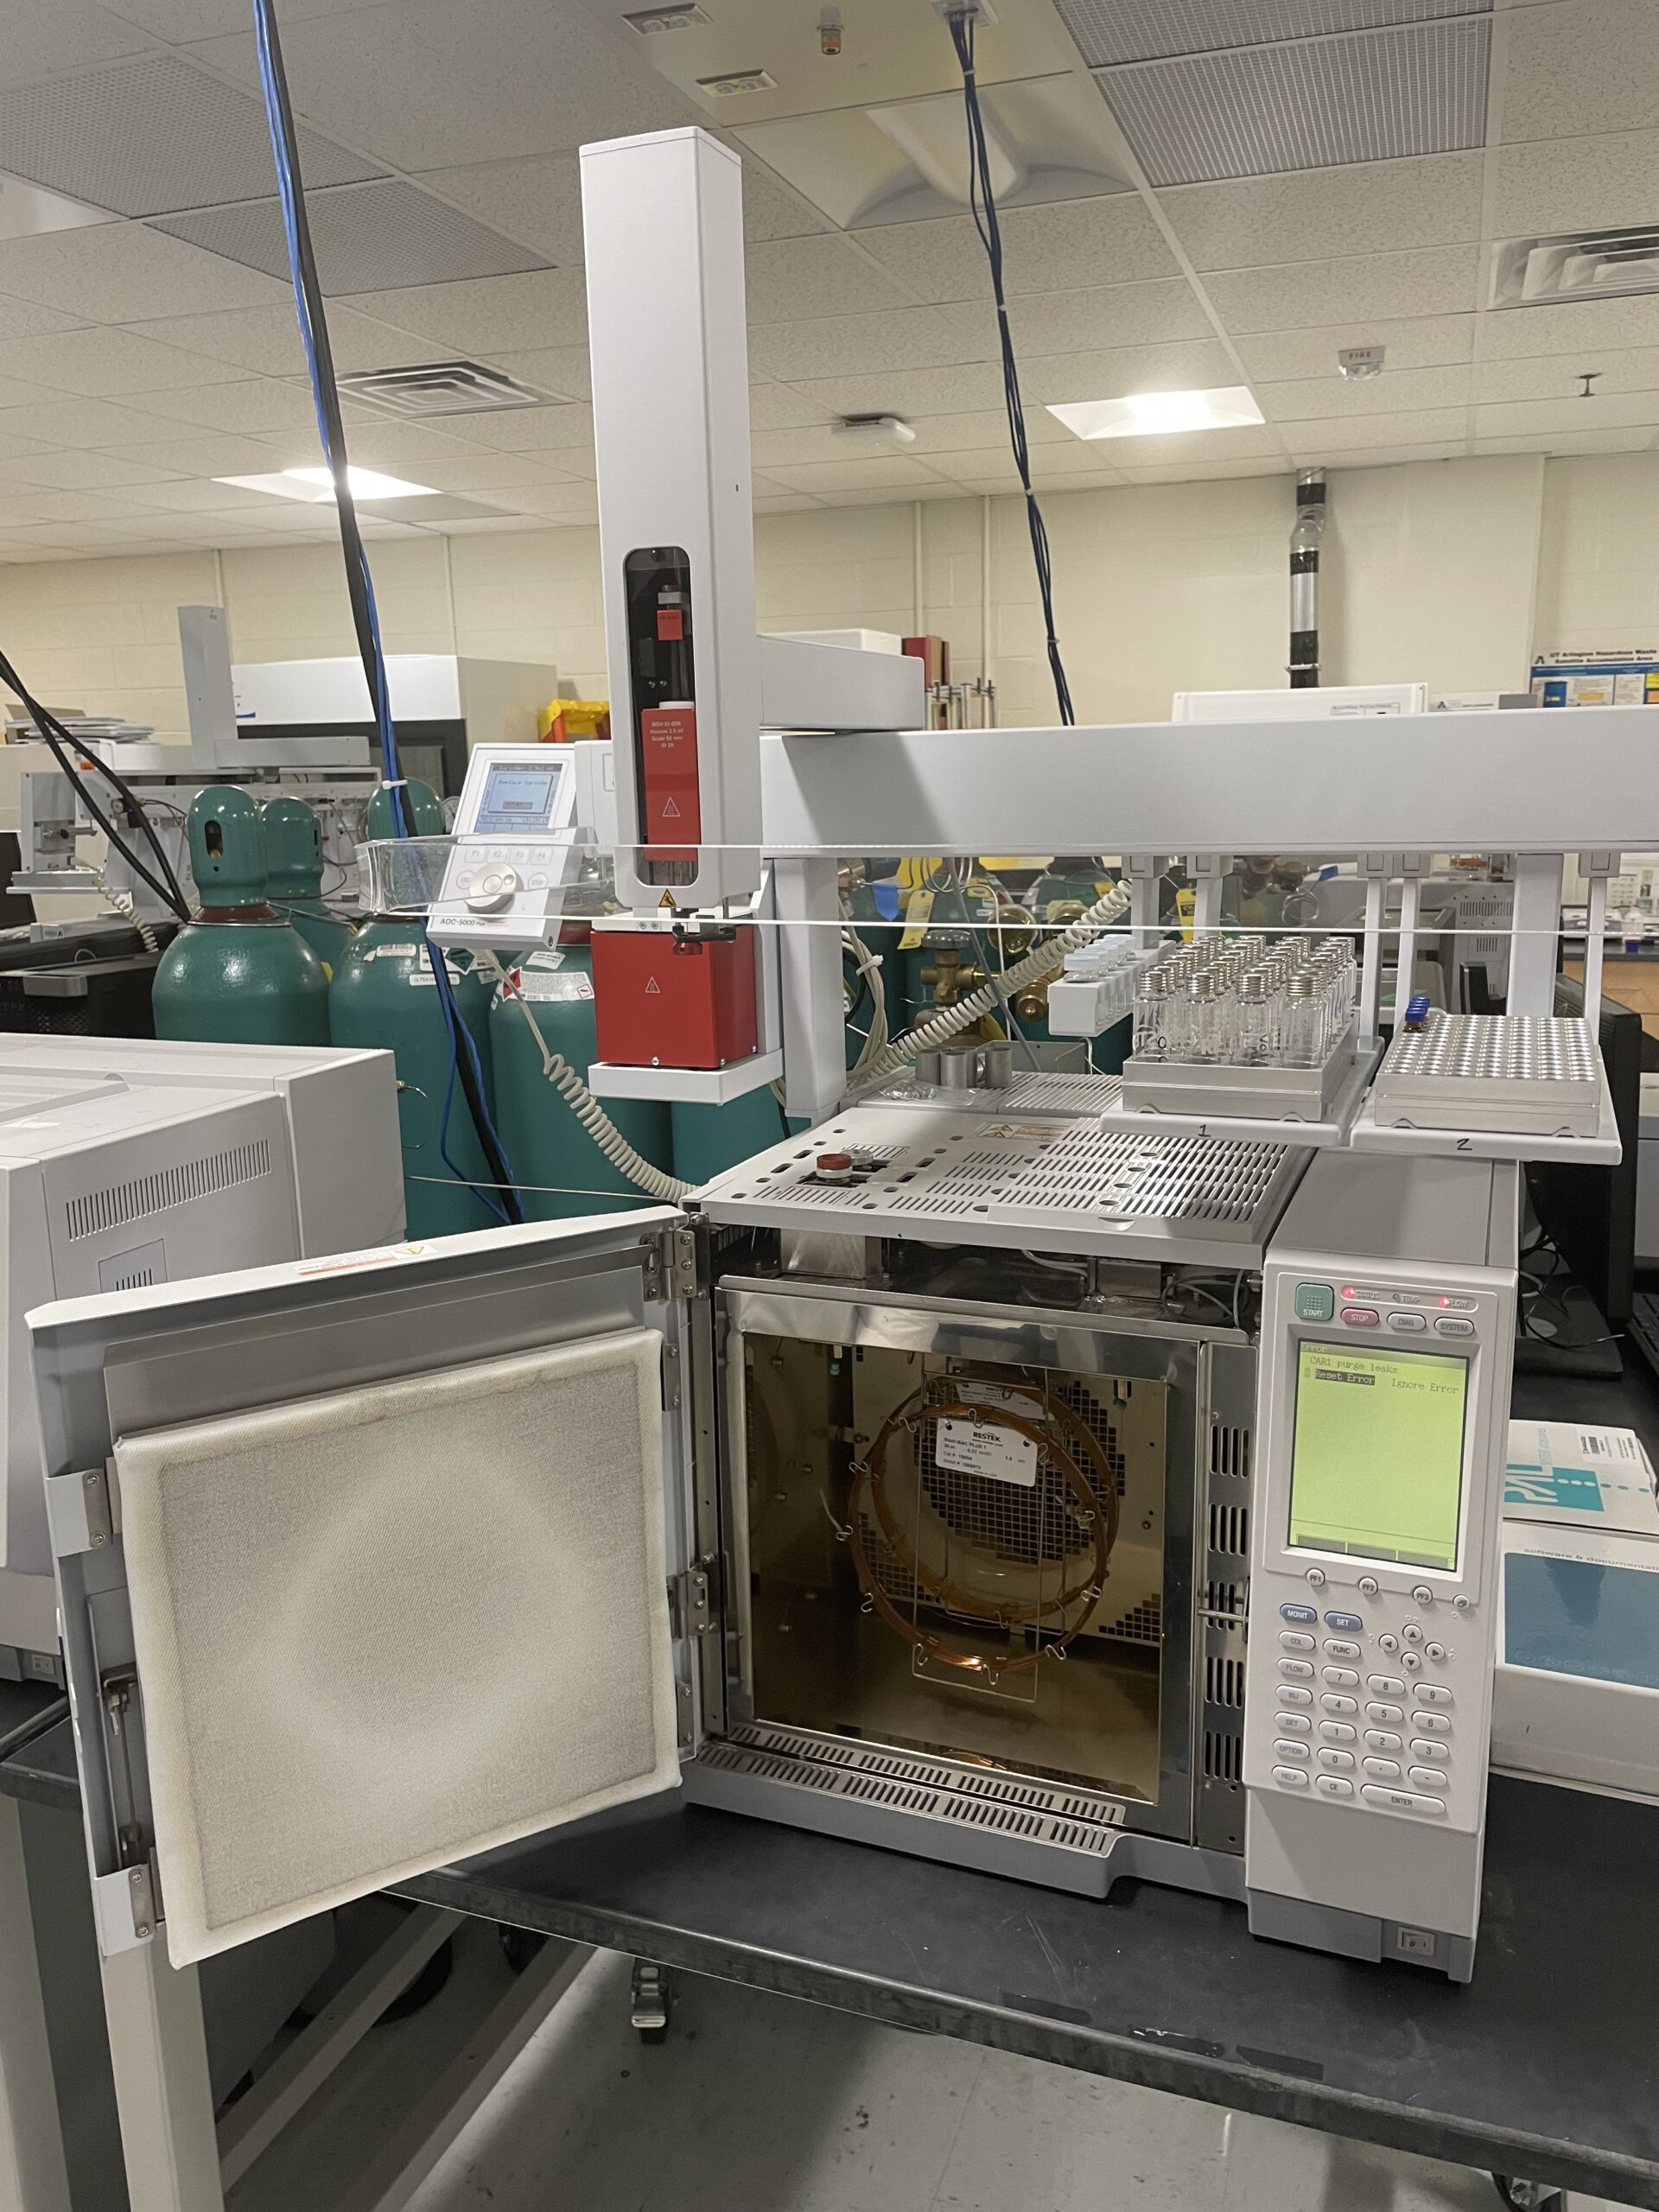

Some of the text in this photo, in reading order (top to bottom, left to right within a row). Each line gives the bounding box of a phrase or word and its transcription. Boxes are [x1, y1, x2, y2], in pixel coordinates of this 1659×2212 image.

[1198, 1124, 1211, 1137] 1
[1456, 1138, 1472, 1151] 2
[1356, 1289, 1380, 1300] STATUS
[1303, 1308, 1324, 1318] START
[1351, 1313, 1369, 1322] STOP
[1398, 1318, 1414, 1326] DIAG
[1440, 1322, 1468, 1332] SYSTEM
[1337, 1360, 1364, 1370] purge
[1370, 1362, 1398, 1373] leaks
[1315, 1370, 1375, 1384] Reset Error
[1391, 1379, 1459, 1394] Ignore Error
[973, 1432, 1001, 1442] RESTEK
[1523, 1548, 1573, 1558] software
[1309, 1573, 1322, 1582] PF1
[1416, 1592, 1429, 1600] PF3
[1287, 1610, 1308, 1619] MONIT
[1336, 1618, 1349, 1627] SET
[1332, 1646, 1350, 1655] FUNC
[1286, 1664, 1304, 1673] FLOW
[1337, 1673, 1343, 1681] 7
[1382, 1681, 1389, 1690] 8
[1429, 1691, 1435, 1700] 9
[1335, 1700, 1341, 1709] 4
[1427, 1719, 1433, 1727] 6
[1380, 1737, 1385, 1745] 2
[1279, 1745, 1303, 1755] OPTION
[1426, 1746, 1432, 1755] 3
[1332, 1755, 1338, 1764] 0
[1281, 1772, 1297, 1781] HELP
[1329, 1783, 1338, 1791] CE
[1391, 1796, 1413, 1807] ENTER
